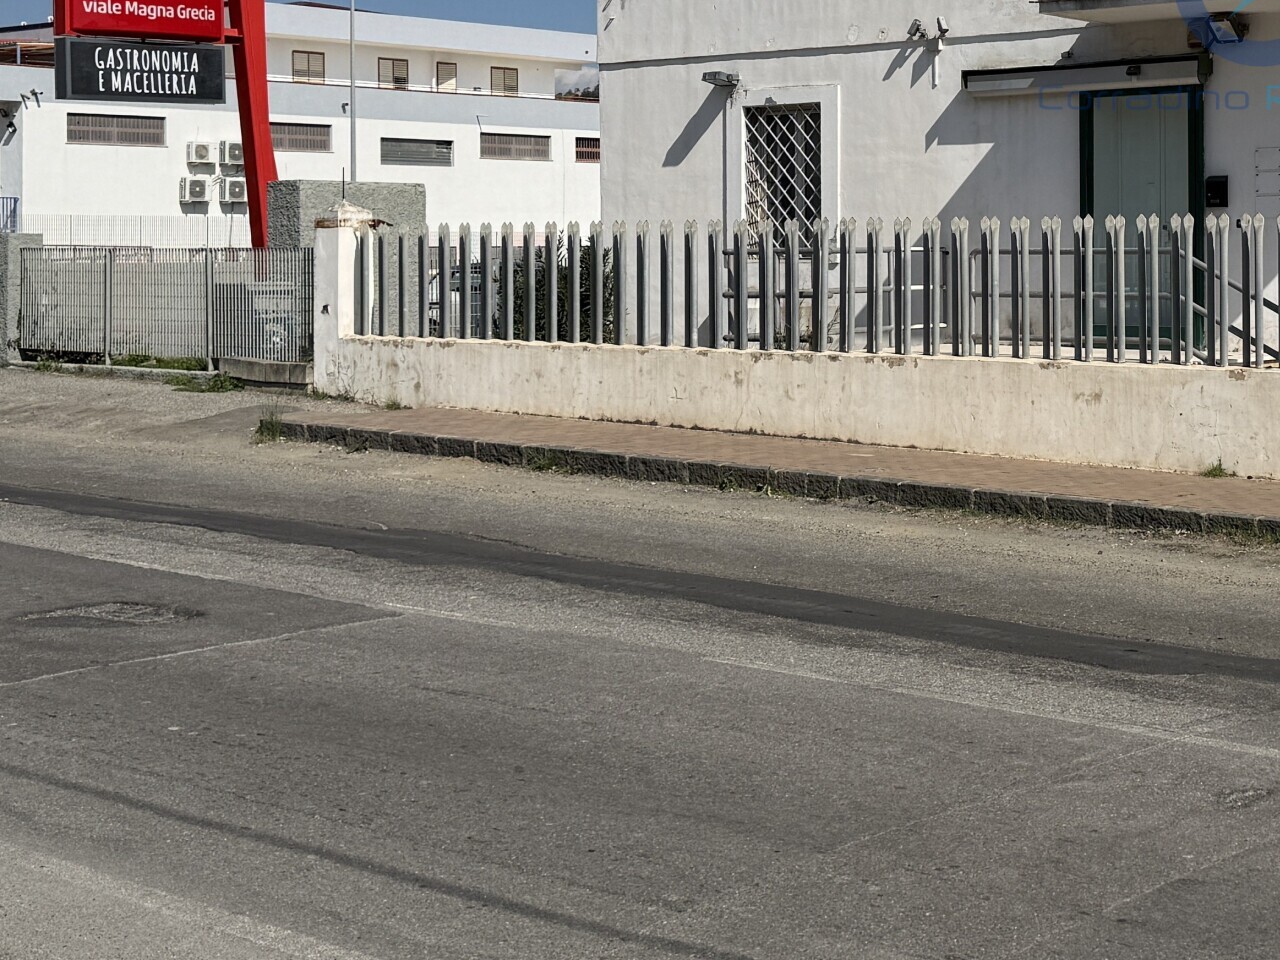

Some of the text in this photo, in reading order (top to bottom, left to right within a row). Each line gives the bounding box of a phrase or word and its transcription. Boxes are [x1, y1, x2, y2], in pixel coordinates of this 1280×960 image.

[125, 1, 175, 20] Magna
[177, 5, 216, 21] Grecia
[94, 47, 199, 72] GASTRONOMIA
[98, 71, 197, 95] E MACELLERIA
